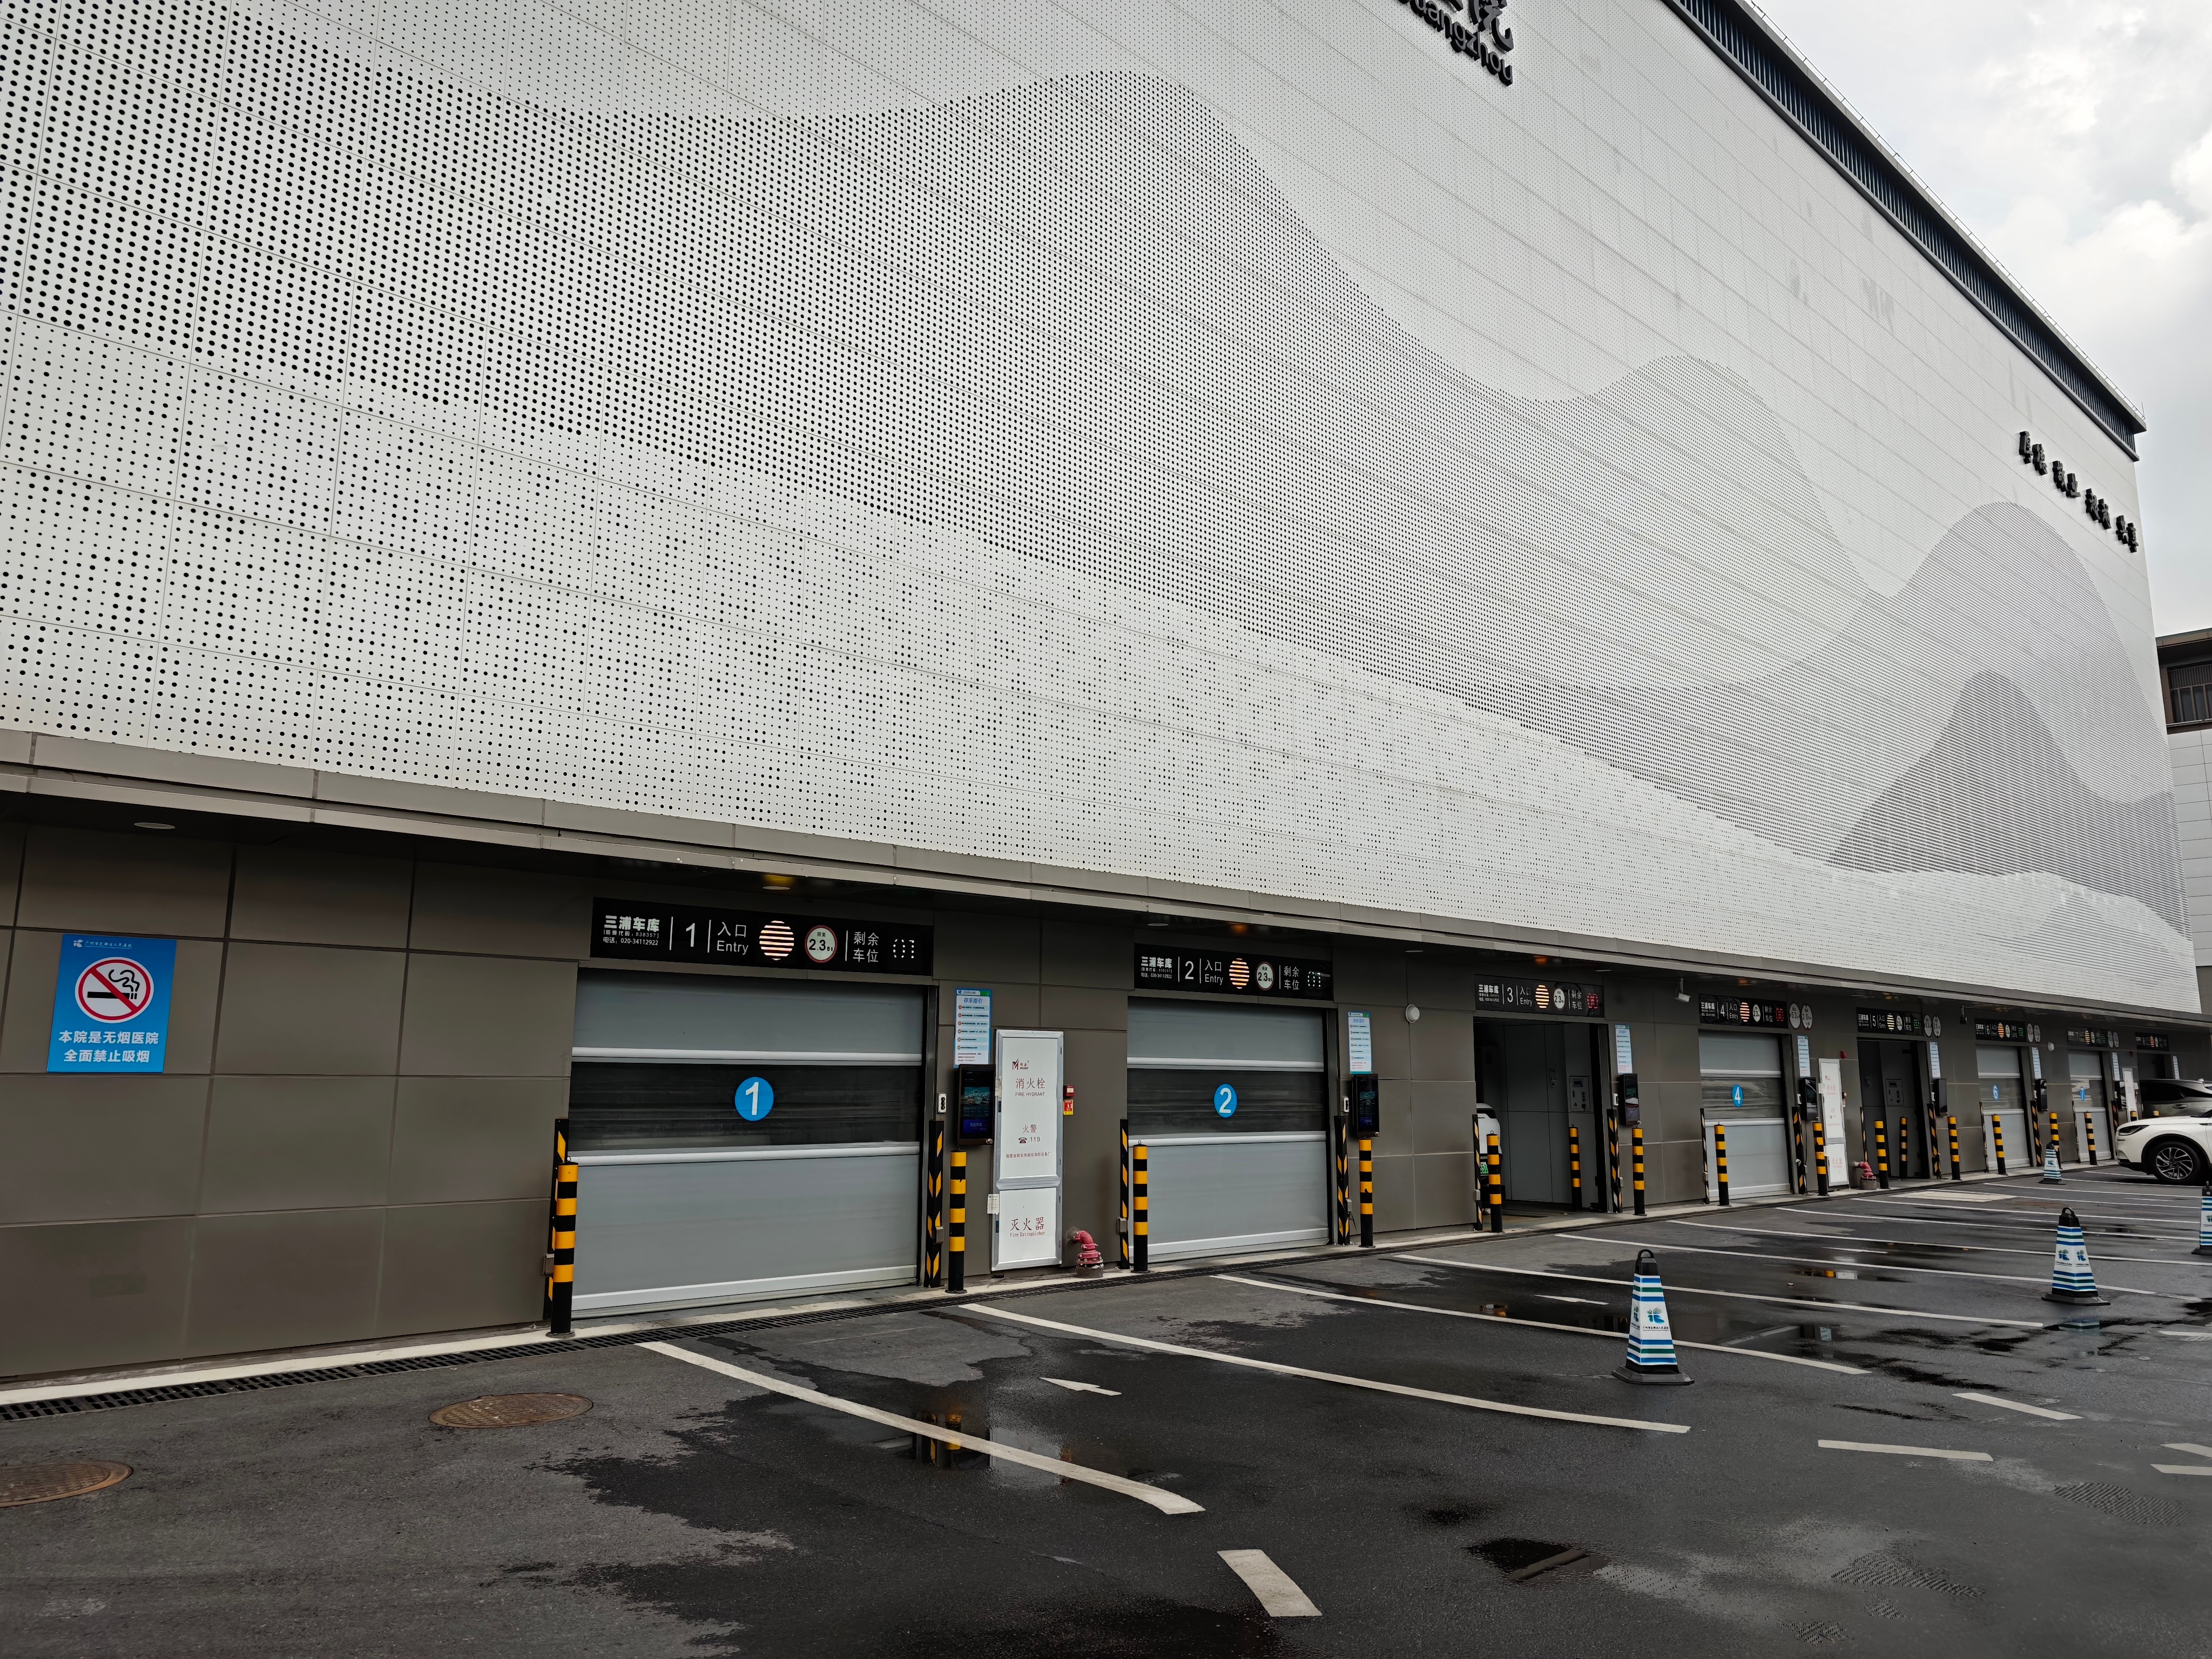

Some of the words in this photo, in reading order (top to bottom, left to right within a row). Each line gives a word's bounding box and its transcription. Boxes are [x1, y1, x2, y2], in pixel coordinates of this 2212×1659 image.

[1397, 0, 1513, 86] uangzhou
[604, 915, 660, 932] 三浦车库
[717, 921, 747, 938] 入口
[686, 922, 696, 947] 1
[853, 932, 879, 946] 剩余
[717, 940, 749, 955] Entry
[853, 948, 879, 963] 车位
[1141, 956, 1172, 969] 三浦车库
[1204, 960, 1222, 972] 入口
[1185, 961, 1194, 980] 2
[1284, 966, 1299, 977] 剩余
[1204, 974, 1223, 986] Entry
[1284, 979, 1300, 990] 车位
[1507, 987, 1513, 1003] 3
[1520, 987, 1531, 996] 入口
[1571, 989, 1582, 1000] 剩余
[1520, 997, 1533, 1007] Entry
[1572, 1000, 1583, 1010] 车位
[1729, 1003, 1737, 1011] 入口
[1720, 1004, 1725, 1017] 4
[1729, 1012, 1739, 1020] Entry
[1872, 1015, 1876, 1027] 5
[58, 1030, 159, 1044] 本院是无烟医院
[1986, 1026, 1990, 1035] 6
[64, 1049, 150, 1063] 全面禁止吸烟
[1015, 1077, 1046, 1089] 消火栓
[745, 1081, 759, 1116] 1
[1734, 1086, 1741, 1104] 4
[1993, 1085, 1998, 1100] 6
[1219, 1088, 1232, 1114] 2
[1022, 1124, 1037, 1134] 火警
[1010, 1217, 1045, 1231] 灭火器
